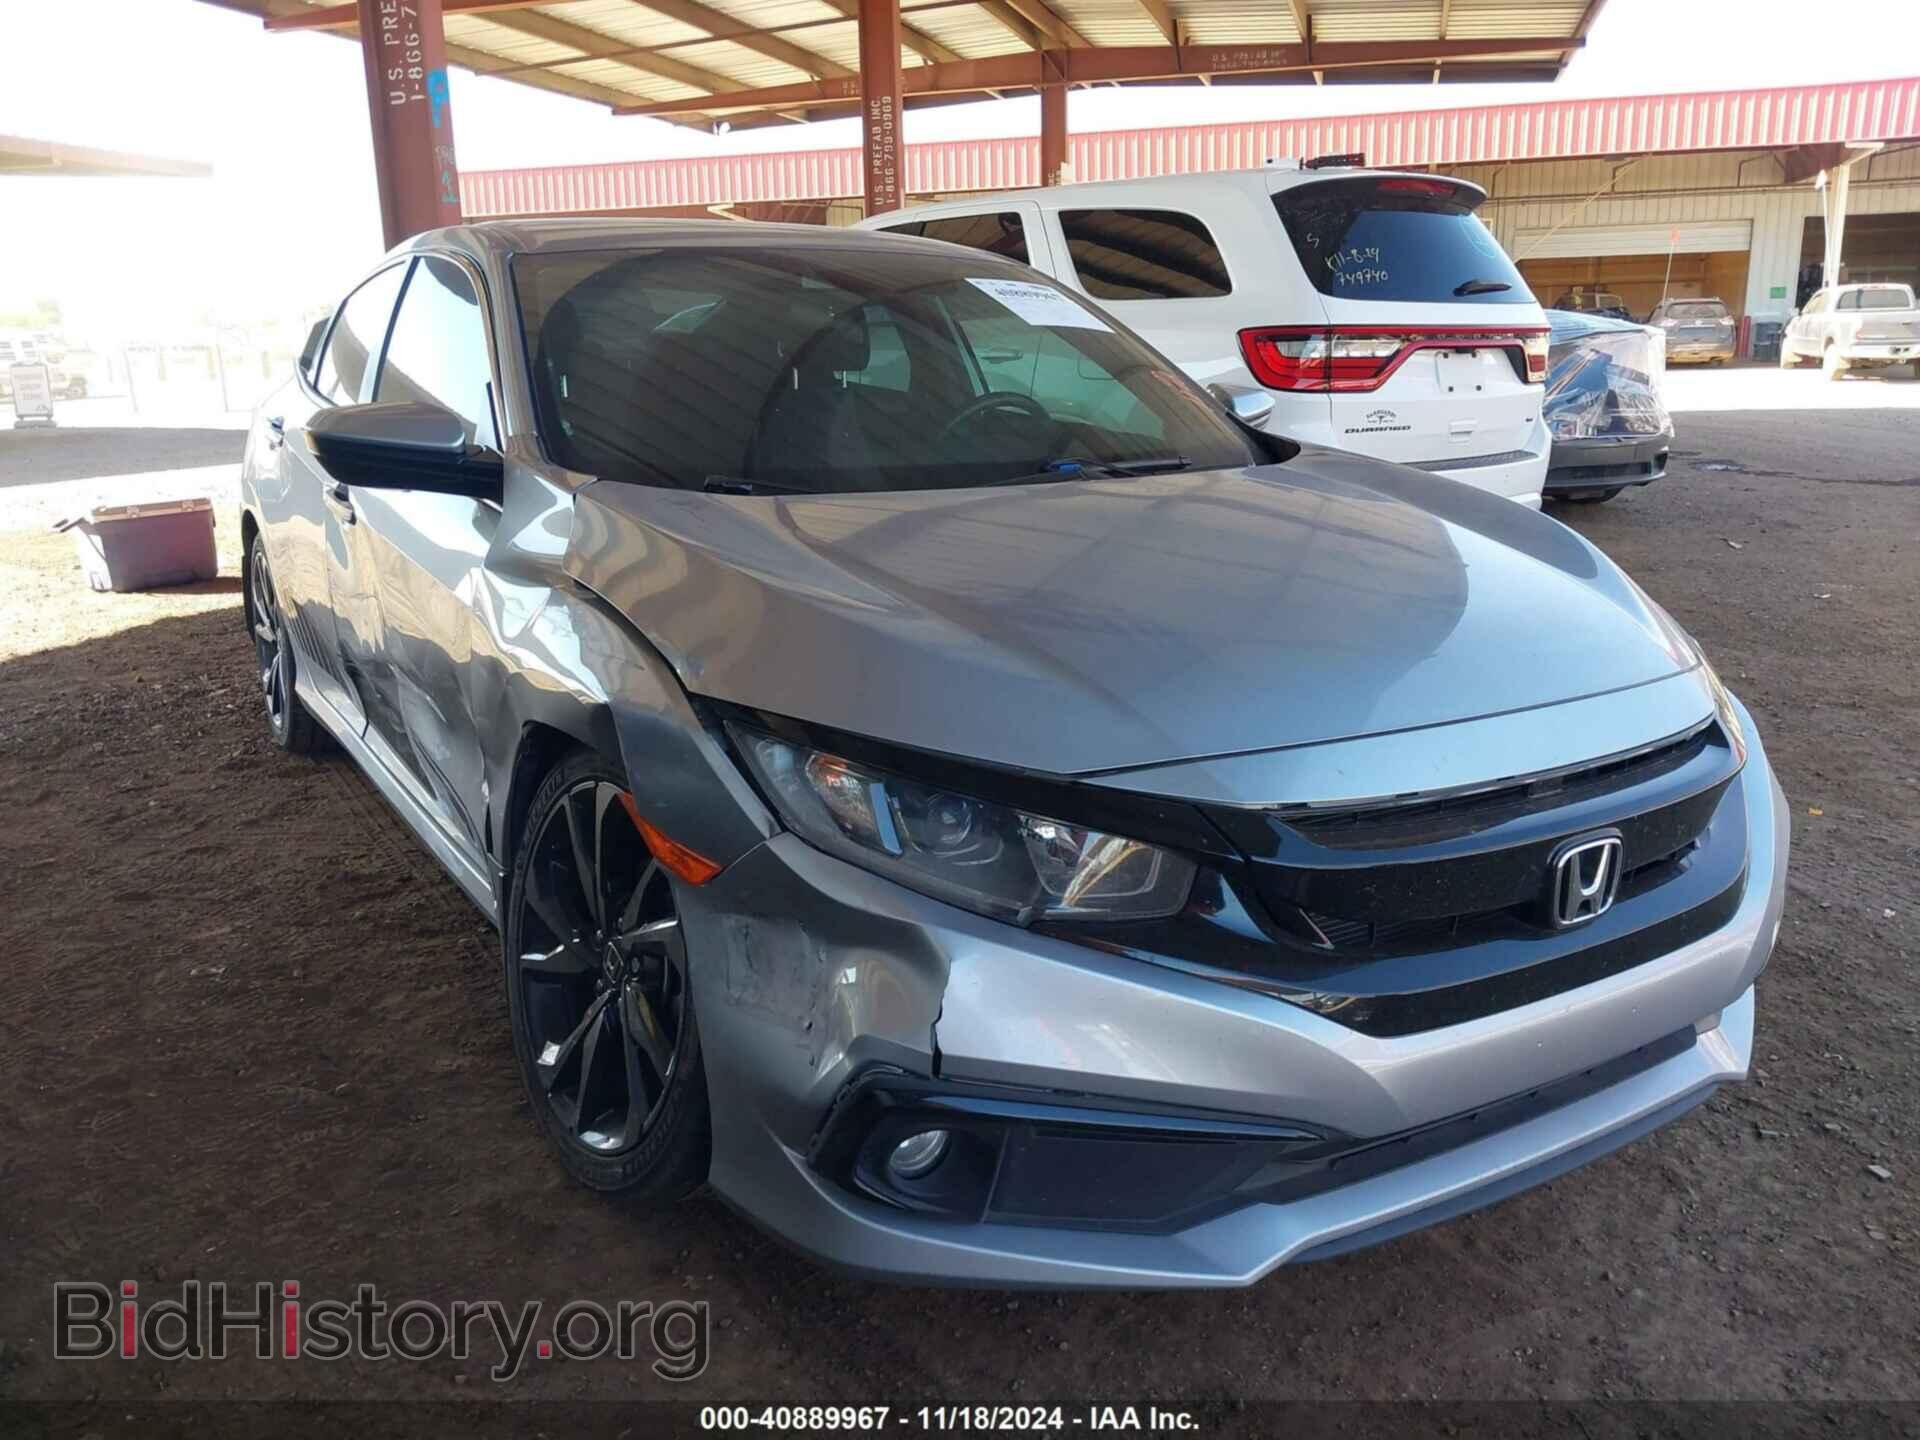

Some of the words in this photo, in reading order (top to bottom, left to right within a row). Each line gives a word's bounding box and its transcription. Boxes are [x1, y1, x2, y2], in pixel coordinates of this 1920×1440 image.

[388, 59, 407, 105] U.S.
[872, 126, 883, 175] PREFAB
[1336, 268, 1390, 287] 749740
